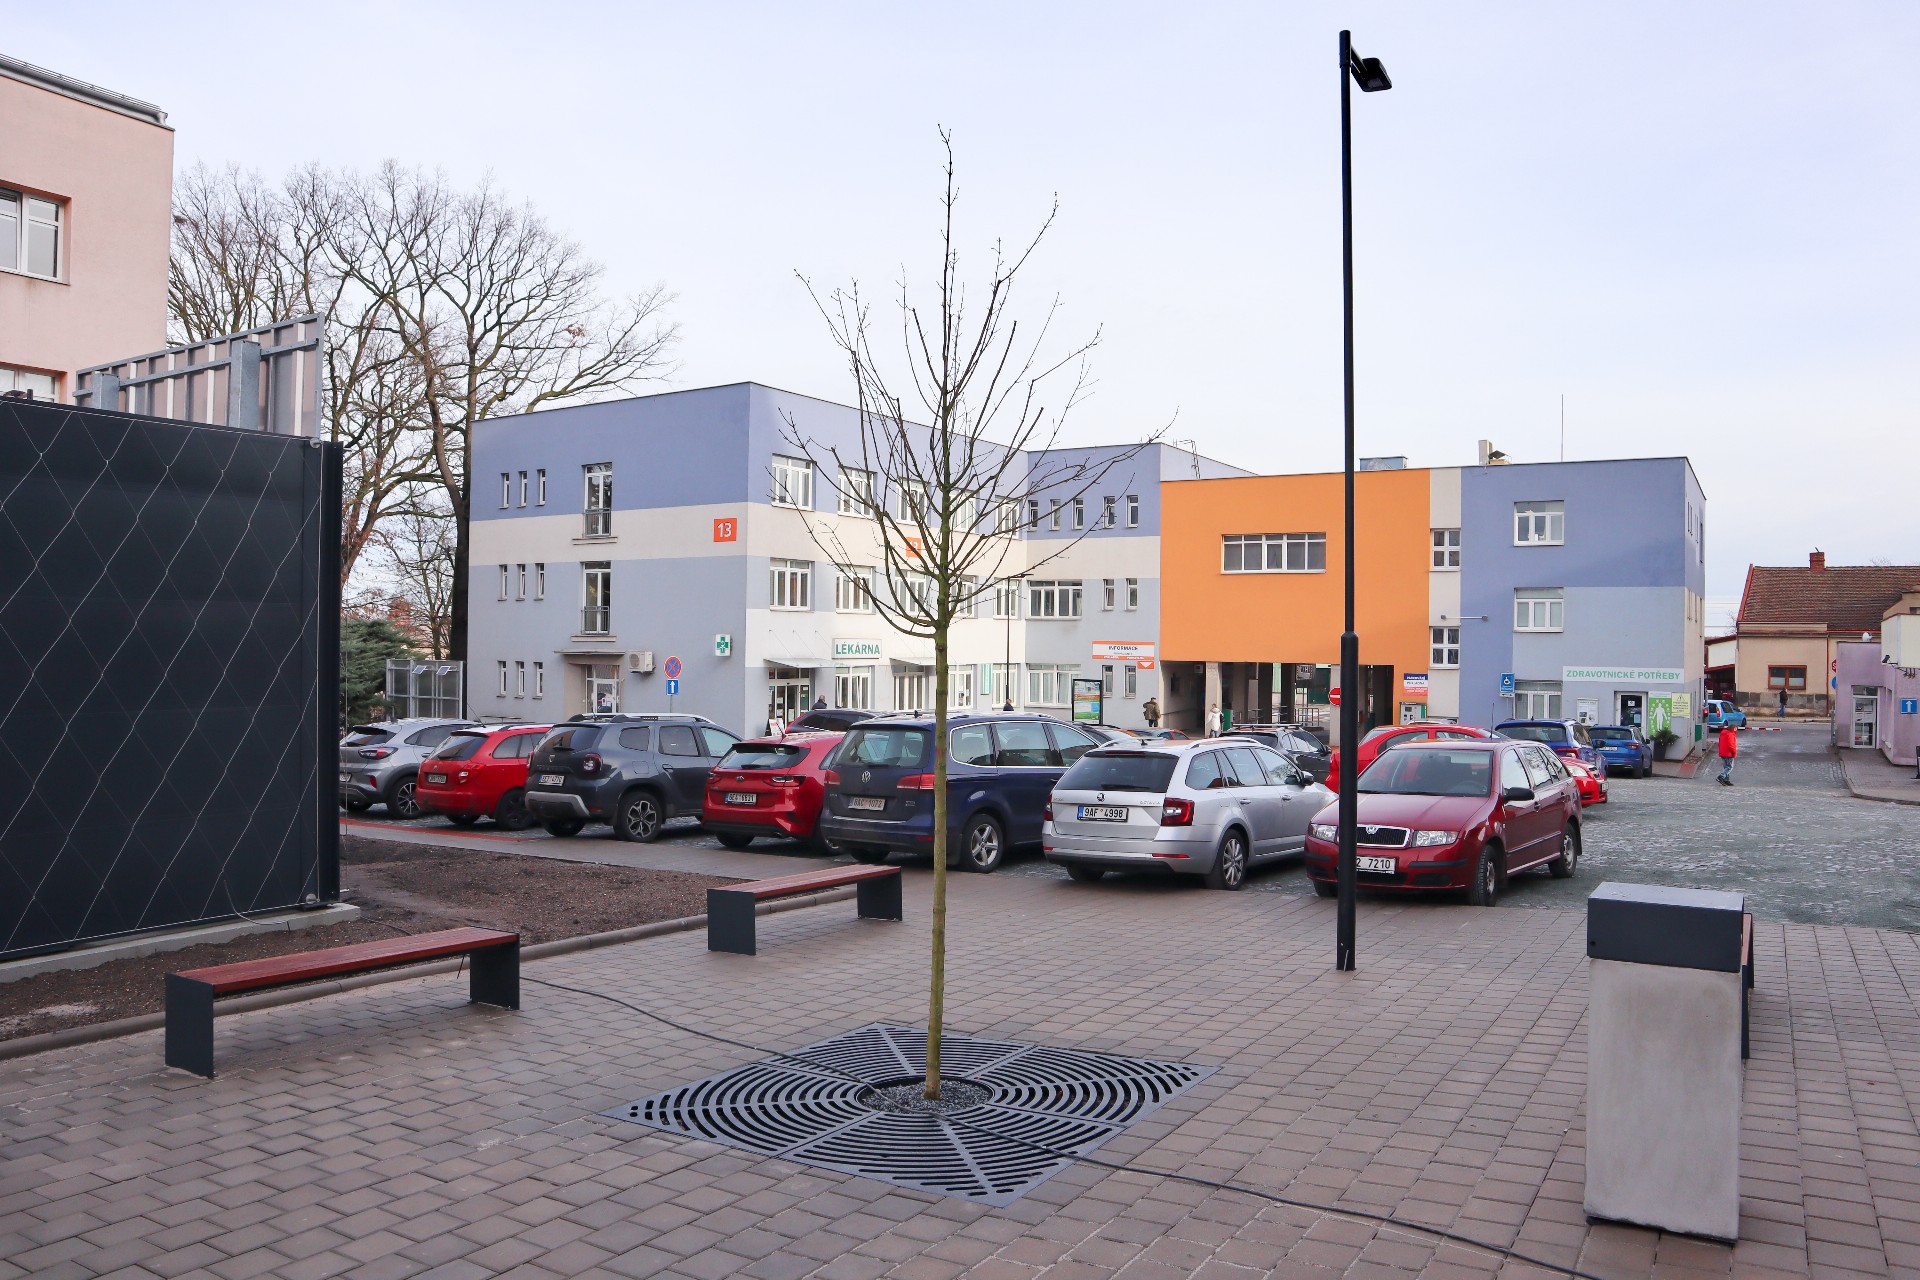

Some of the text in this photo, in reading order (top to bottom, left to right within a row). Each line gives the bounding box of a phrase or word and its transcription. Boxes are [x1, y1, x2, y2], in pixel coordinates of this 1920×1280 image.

[717, 522, 732, 538] 13
[835, 641, 881, 655] LÉKÁRNA
[1566, 669, 1681, 680] ZDRAVOTNICKÉ POTŘEBY
[868, 799, 883, 808] 1072
[1084, 807, 1124, 818] 9AF 4998
[1368, 858, 1391, 869] 7210
